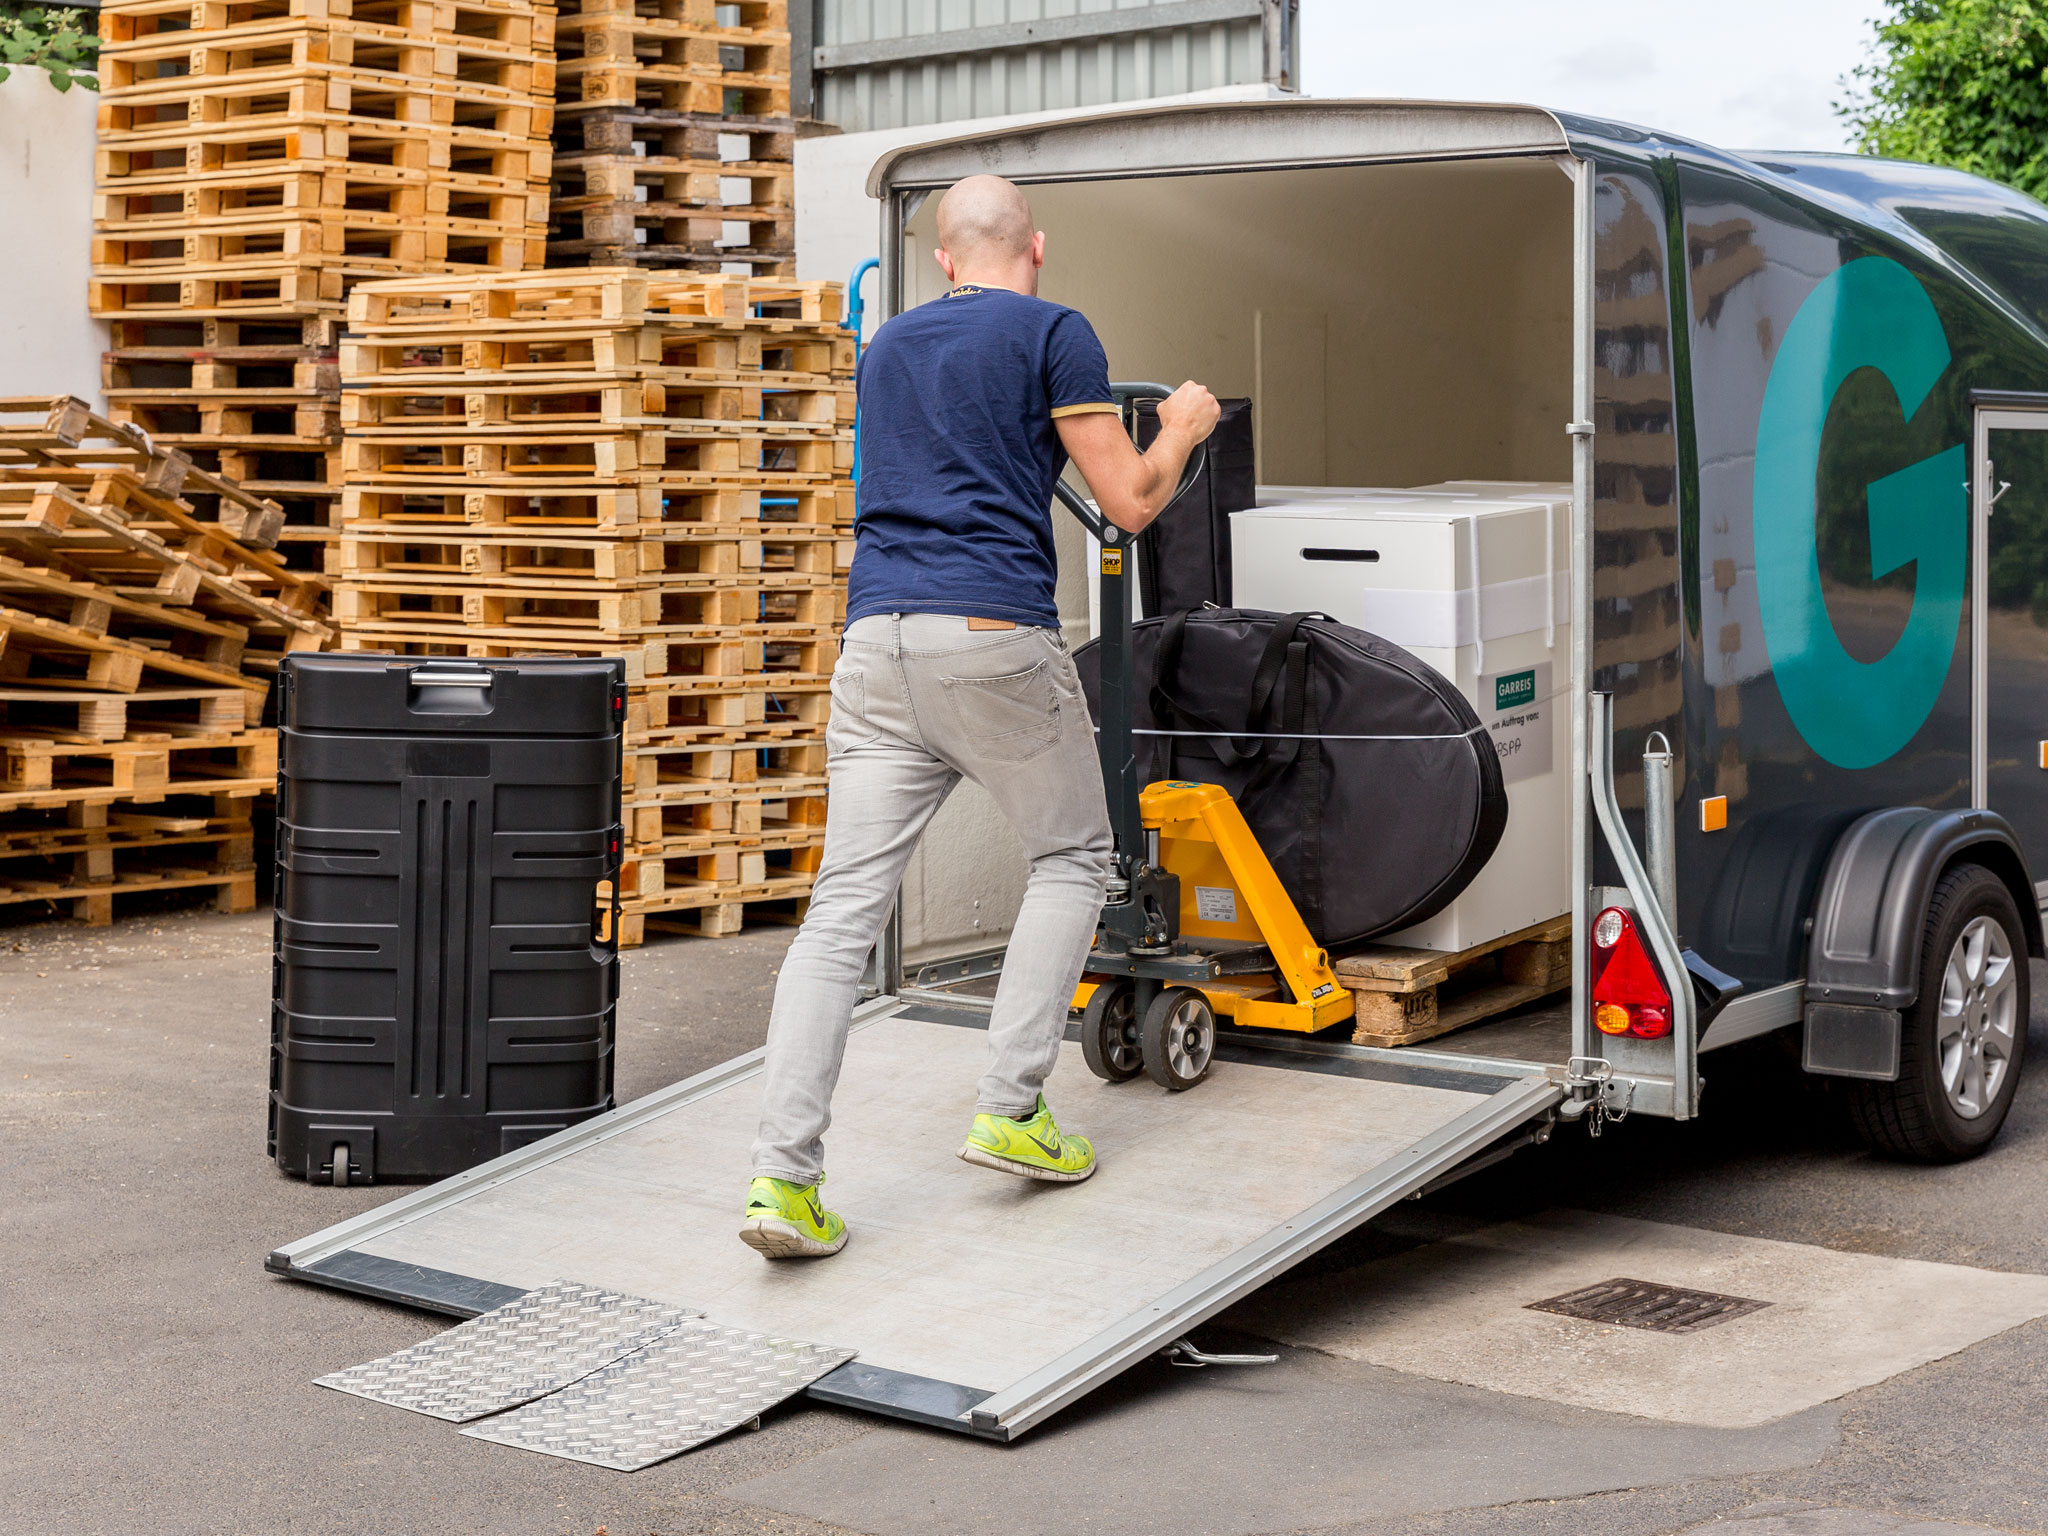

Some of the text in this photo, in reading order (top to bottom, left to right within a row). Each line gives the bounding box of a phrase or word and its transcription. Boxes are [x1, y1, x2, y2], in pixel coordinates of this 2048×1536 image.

[1753, 257, 1967, 769] G
[1103, 557, 1120, 566] SHOP
[1498, 678, 1532, 697] GARREIS
[1494, 737, 1522, 758] ASPA
